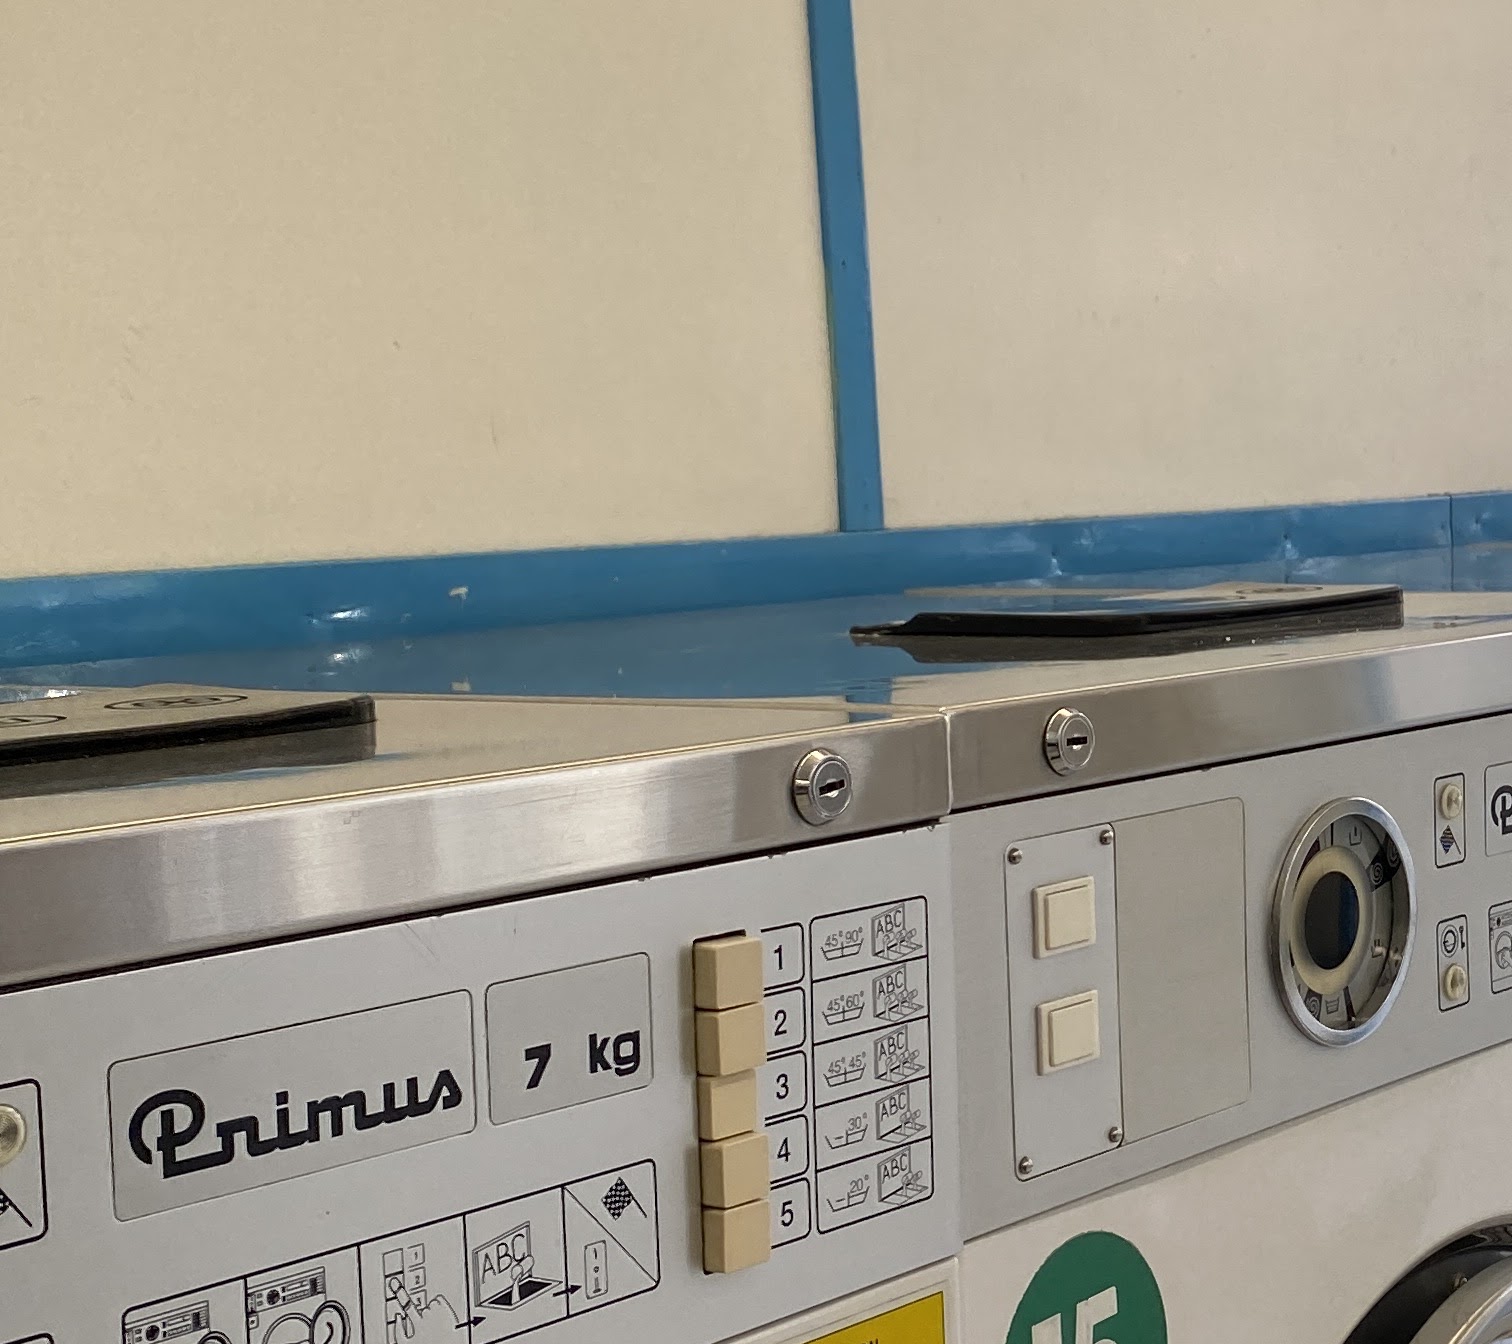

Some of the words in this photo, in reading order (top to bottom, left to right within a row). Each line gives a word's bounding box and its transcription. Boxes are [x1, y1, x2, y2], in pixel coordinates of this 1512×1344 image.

[875, 908, 902, 937] ABC
[774, 945, 784, 971] 1
[773, 1009, 788, 1037] 2
[524, 1042, 552, 1090] 7
[588, 1029, 641, 1077] kg
[775, 1074, 789, 1100] 3
[128, 1068, 463, 1180] Primus
[777, 1137, 791, 1163] 4
[780, 1200, 794, 1227] 5
[481, 1232, 526, 1284] ABC
